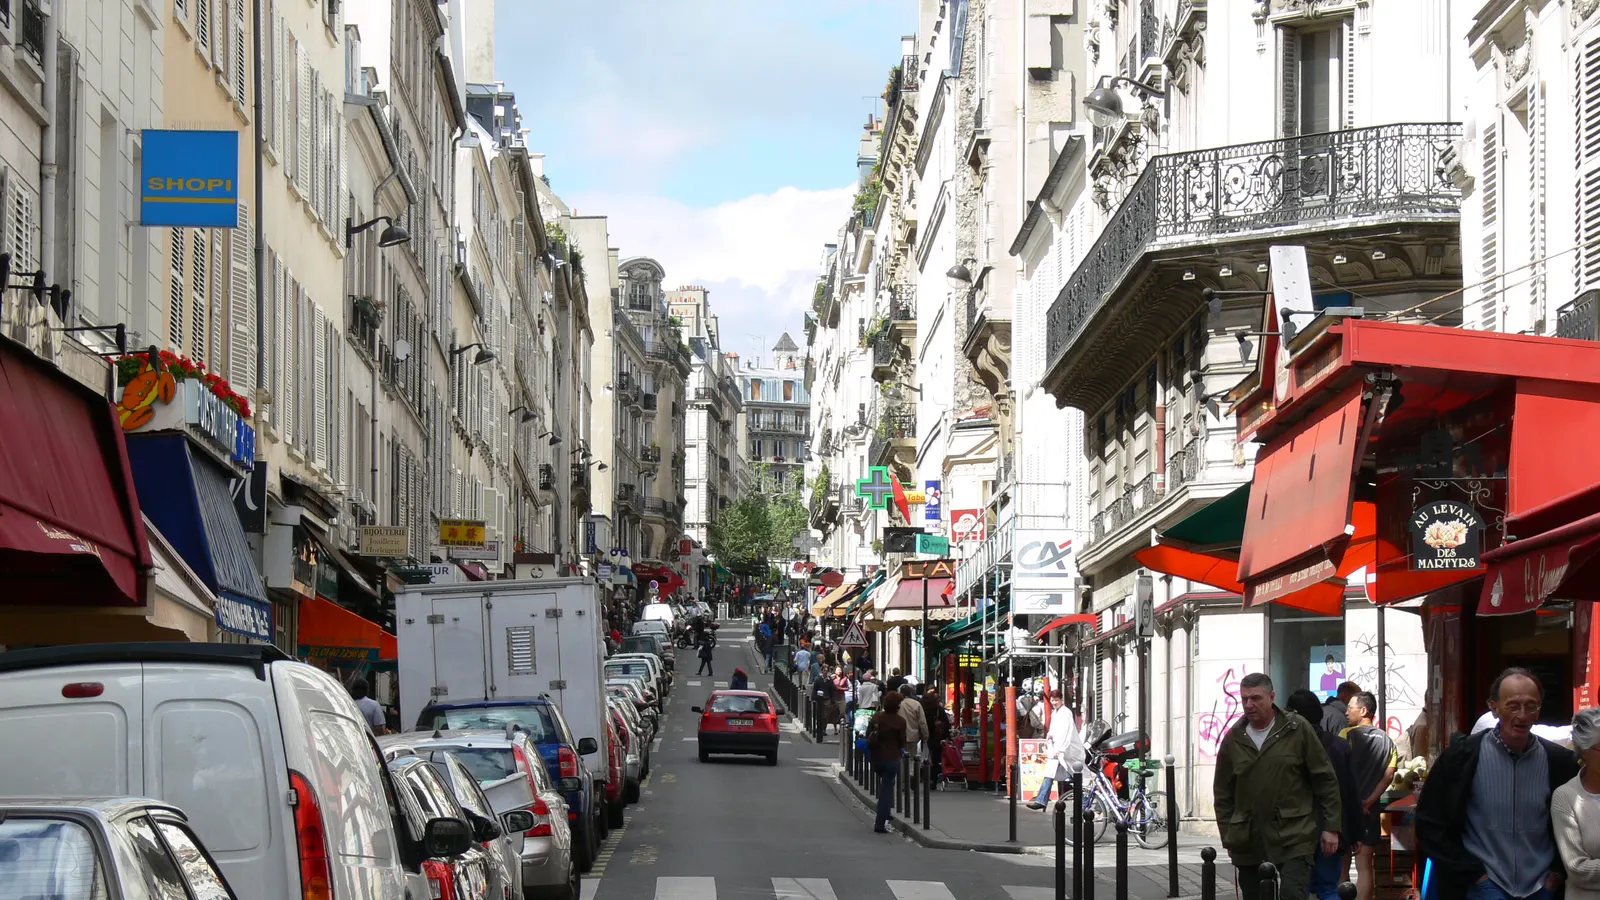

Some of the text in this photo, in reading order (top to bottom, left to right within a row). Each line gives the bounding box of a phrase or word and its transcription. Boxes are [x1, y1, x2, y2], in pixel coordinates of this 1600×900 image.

[147, 177, 232, 191] SHOPI
[907, 493, 925, 501] Taba
[1414, 504, 1477, 529] AU LEVAIN
[364, 528, 406, 537] BIJOUTERIE
[368, 537, 400, 546] Joaillerie
[365, 546, 404, 554] Horlogerie
[1437, 548, 1457, 558] DES
[1418, 558, 1476, 569] MARTYRS
